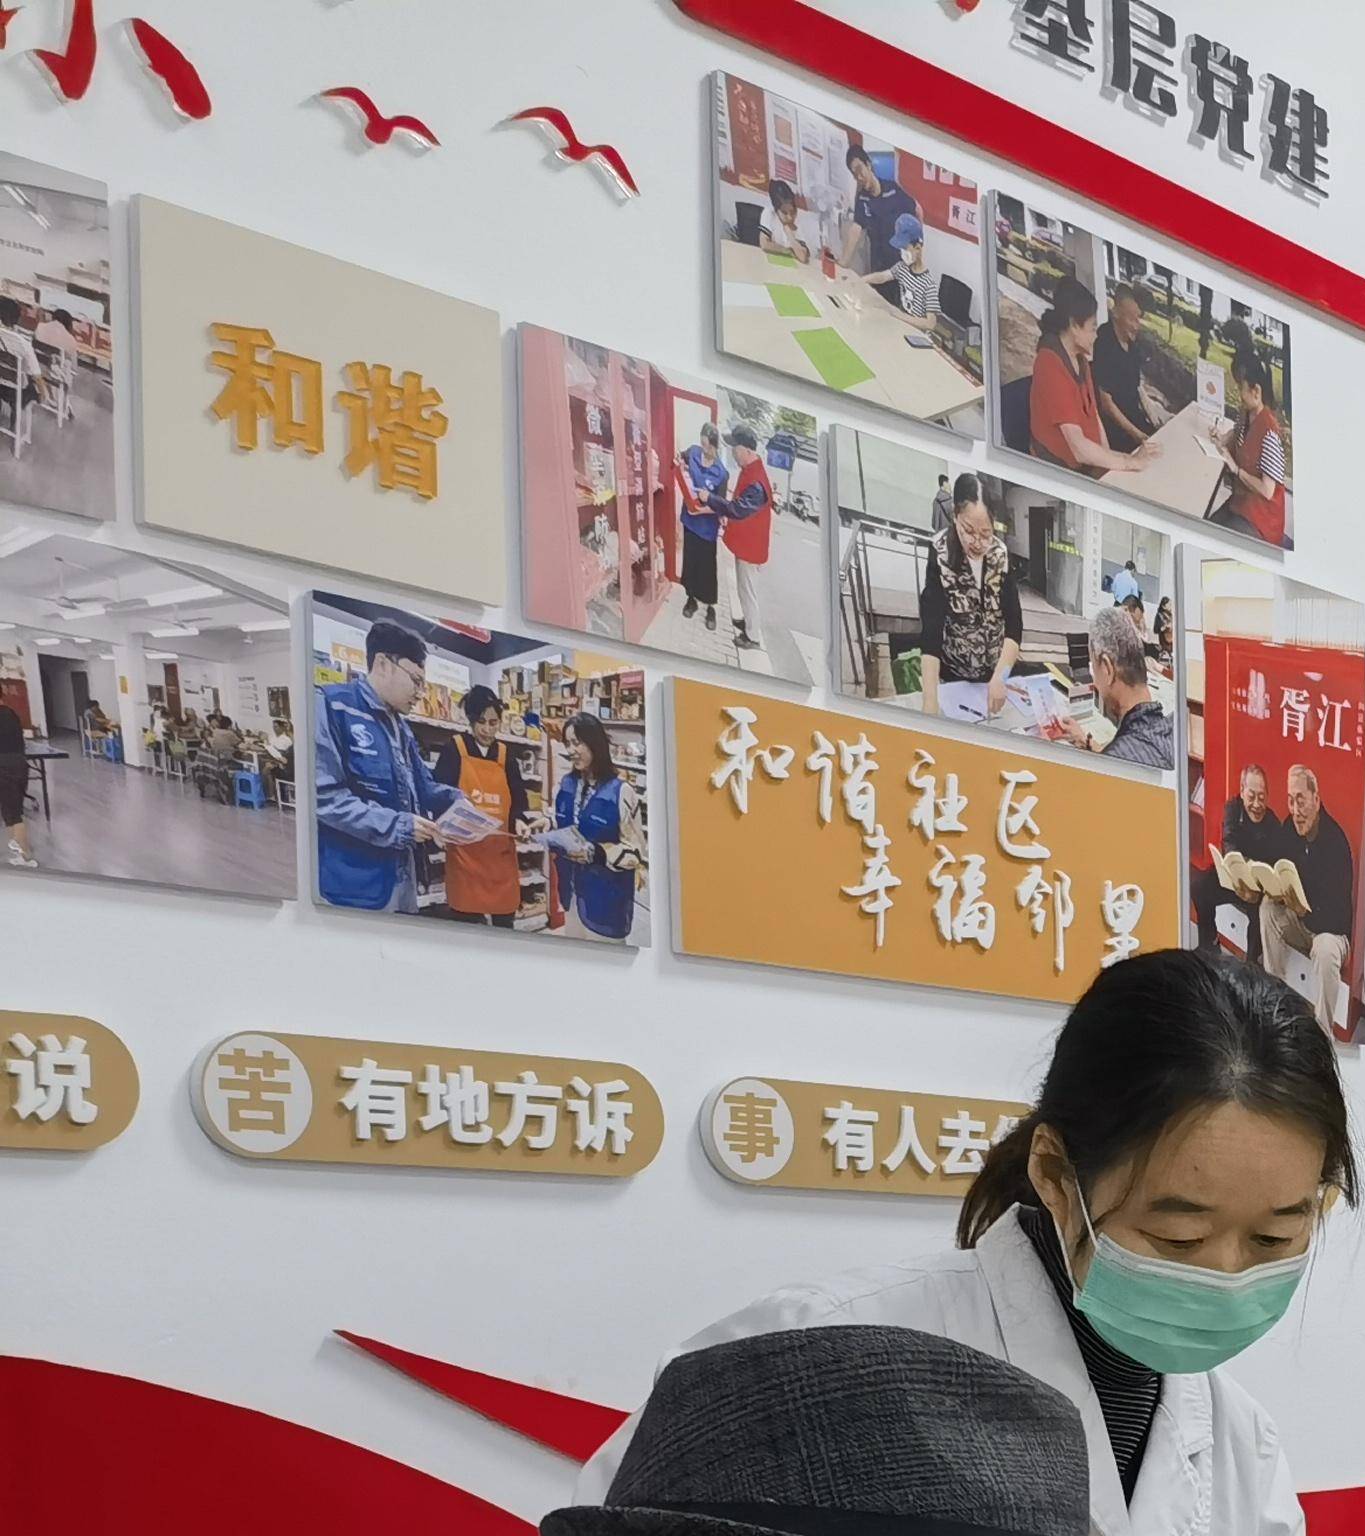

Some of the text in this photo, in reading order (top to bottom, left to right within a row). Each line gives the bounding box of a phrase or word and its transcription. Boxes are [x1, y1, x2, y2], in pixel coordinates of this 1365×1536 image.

[210, 321, 449, 502] 和谐
[1280, 686, 1352, 752] 胥江
[710, 706, 1052, 859] 和谐社区
[840, 823, 1145, 973] 幸福邻里
[6, 1033, 98, 1126] 说
[216, 1048, 635, 1157] 苦 有地方诉
[722, 1092, 1020, 1176] 事 有人去
